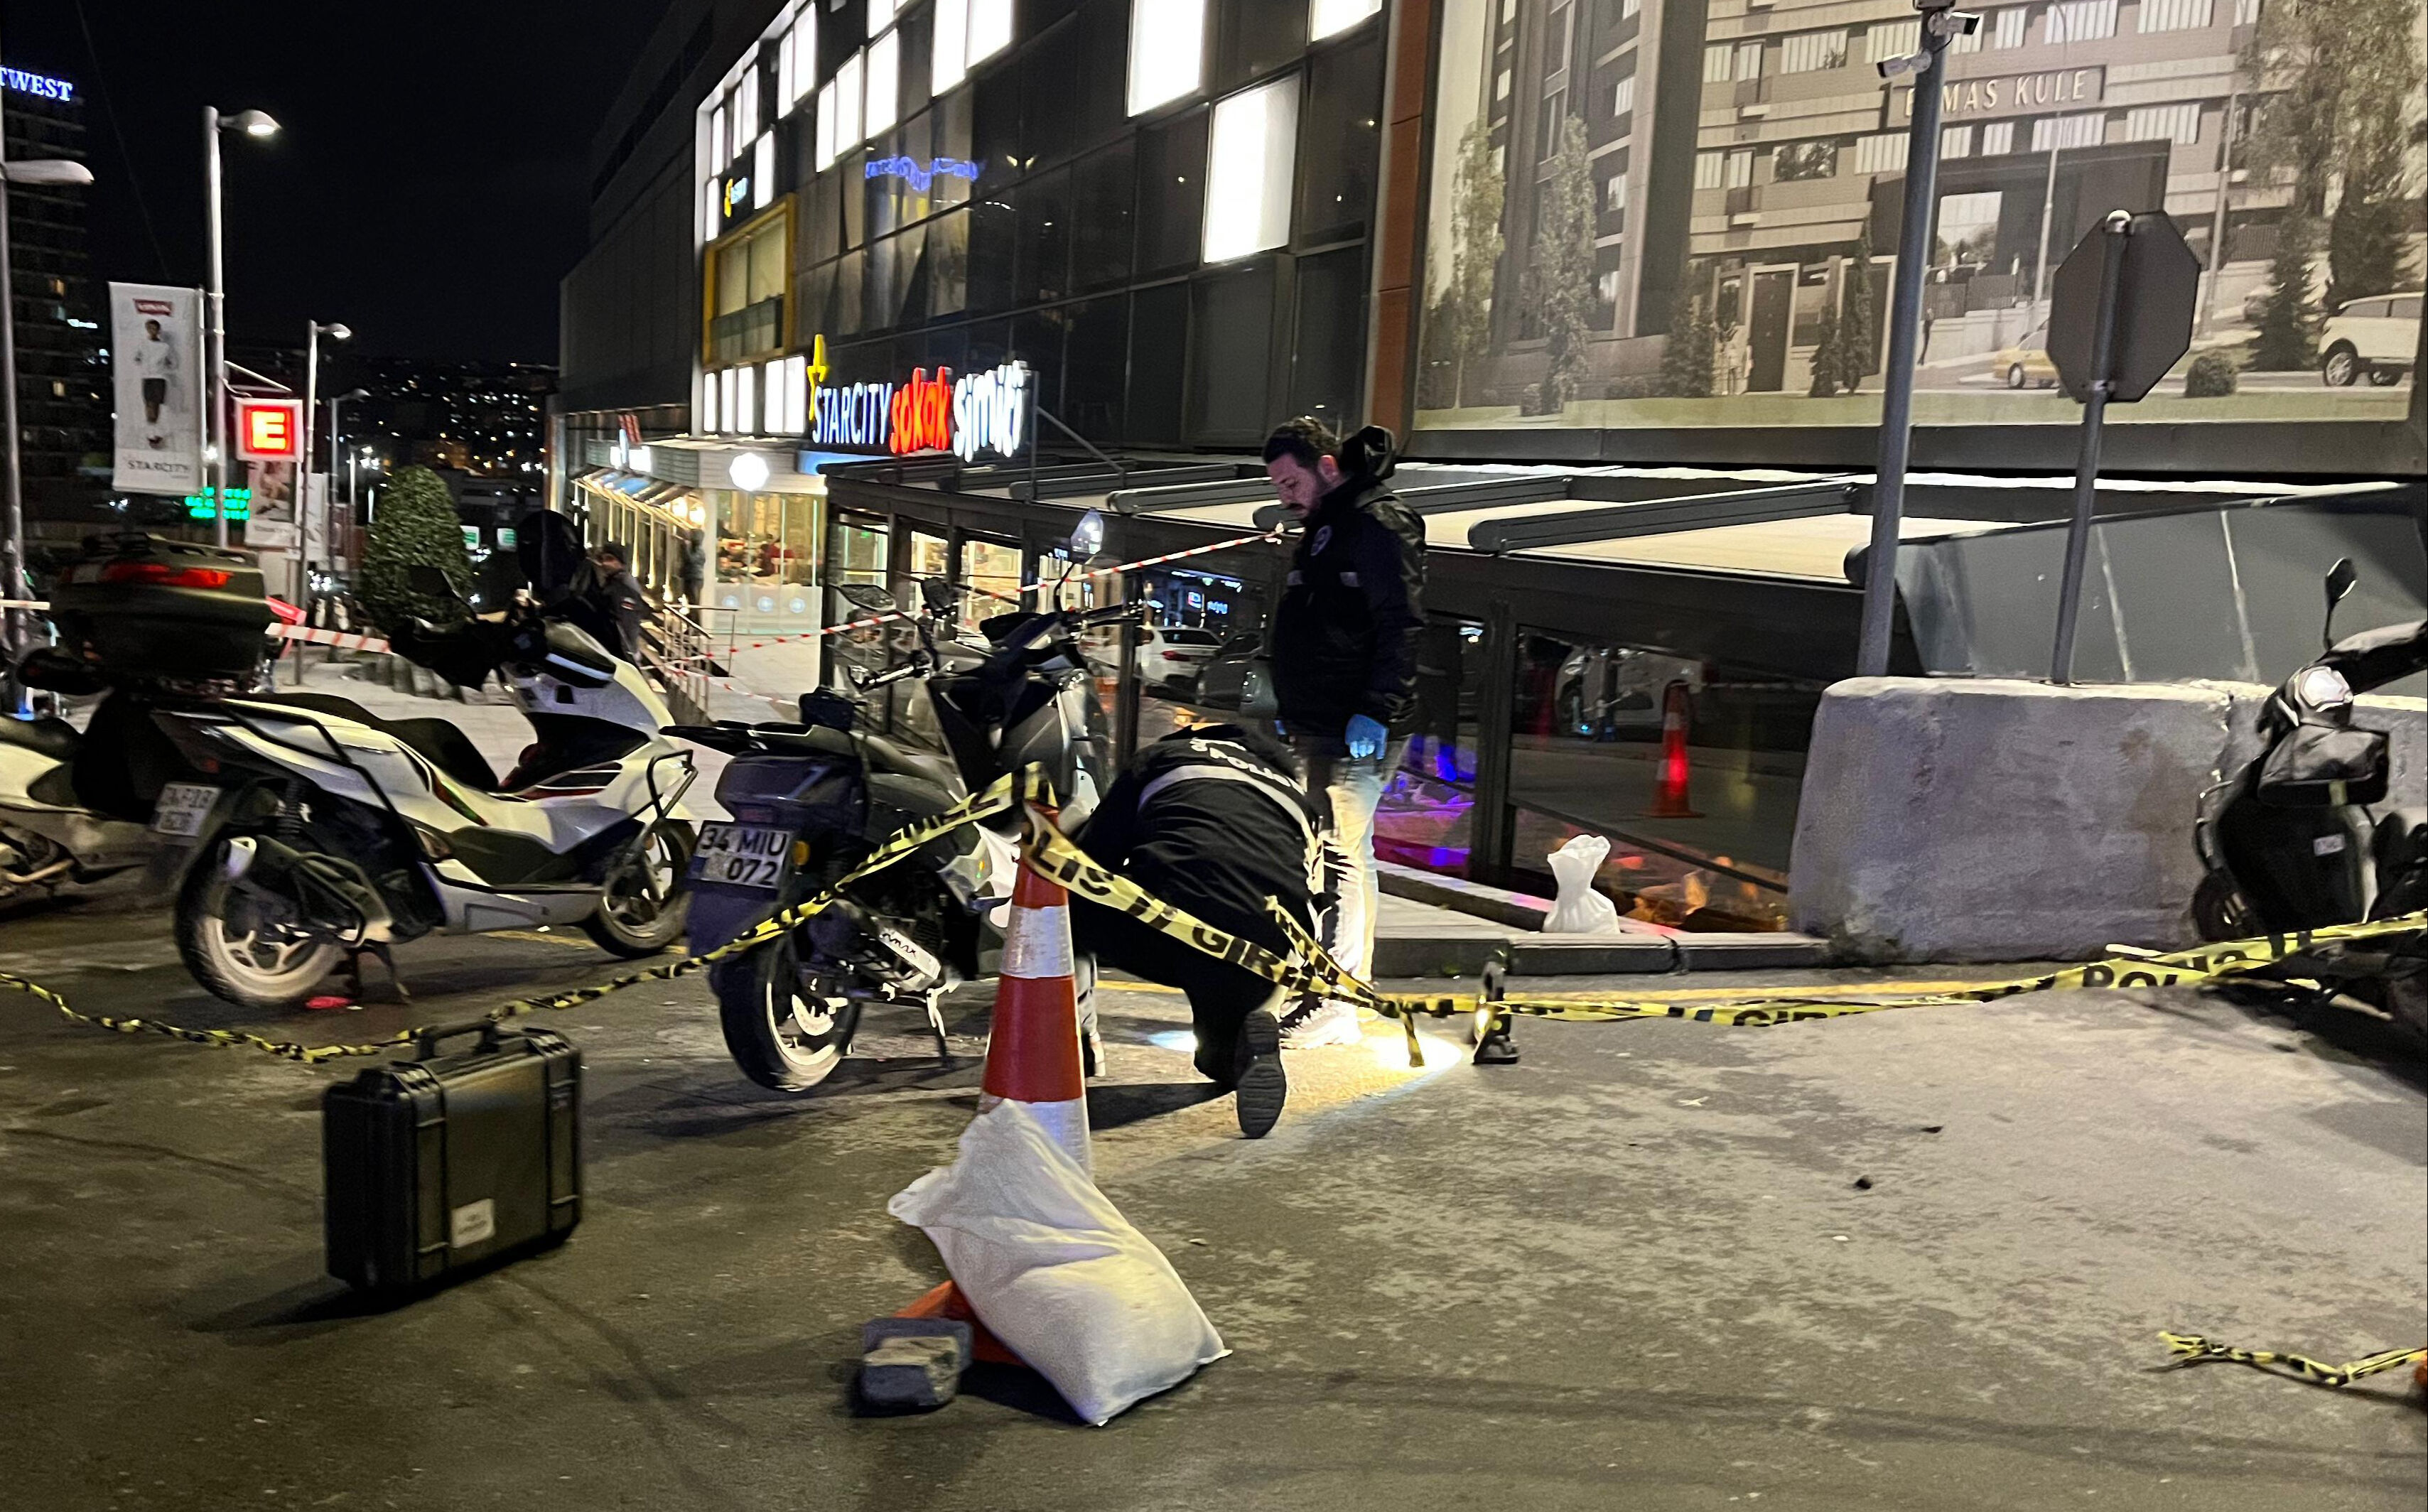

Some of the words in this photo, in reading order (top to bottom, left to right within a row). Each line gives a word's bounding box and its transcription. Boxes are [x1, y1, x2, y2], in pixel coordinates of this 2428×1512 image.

[2014, 70, 2088, 105] KULE
[252, 411, 286, 450] E
[812, 382, 892, 444] STARCITY
[701, 828, 730, 851] 34
[737, 830, 787, 856] MIU
[727, 858, 777, 885] 072
